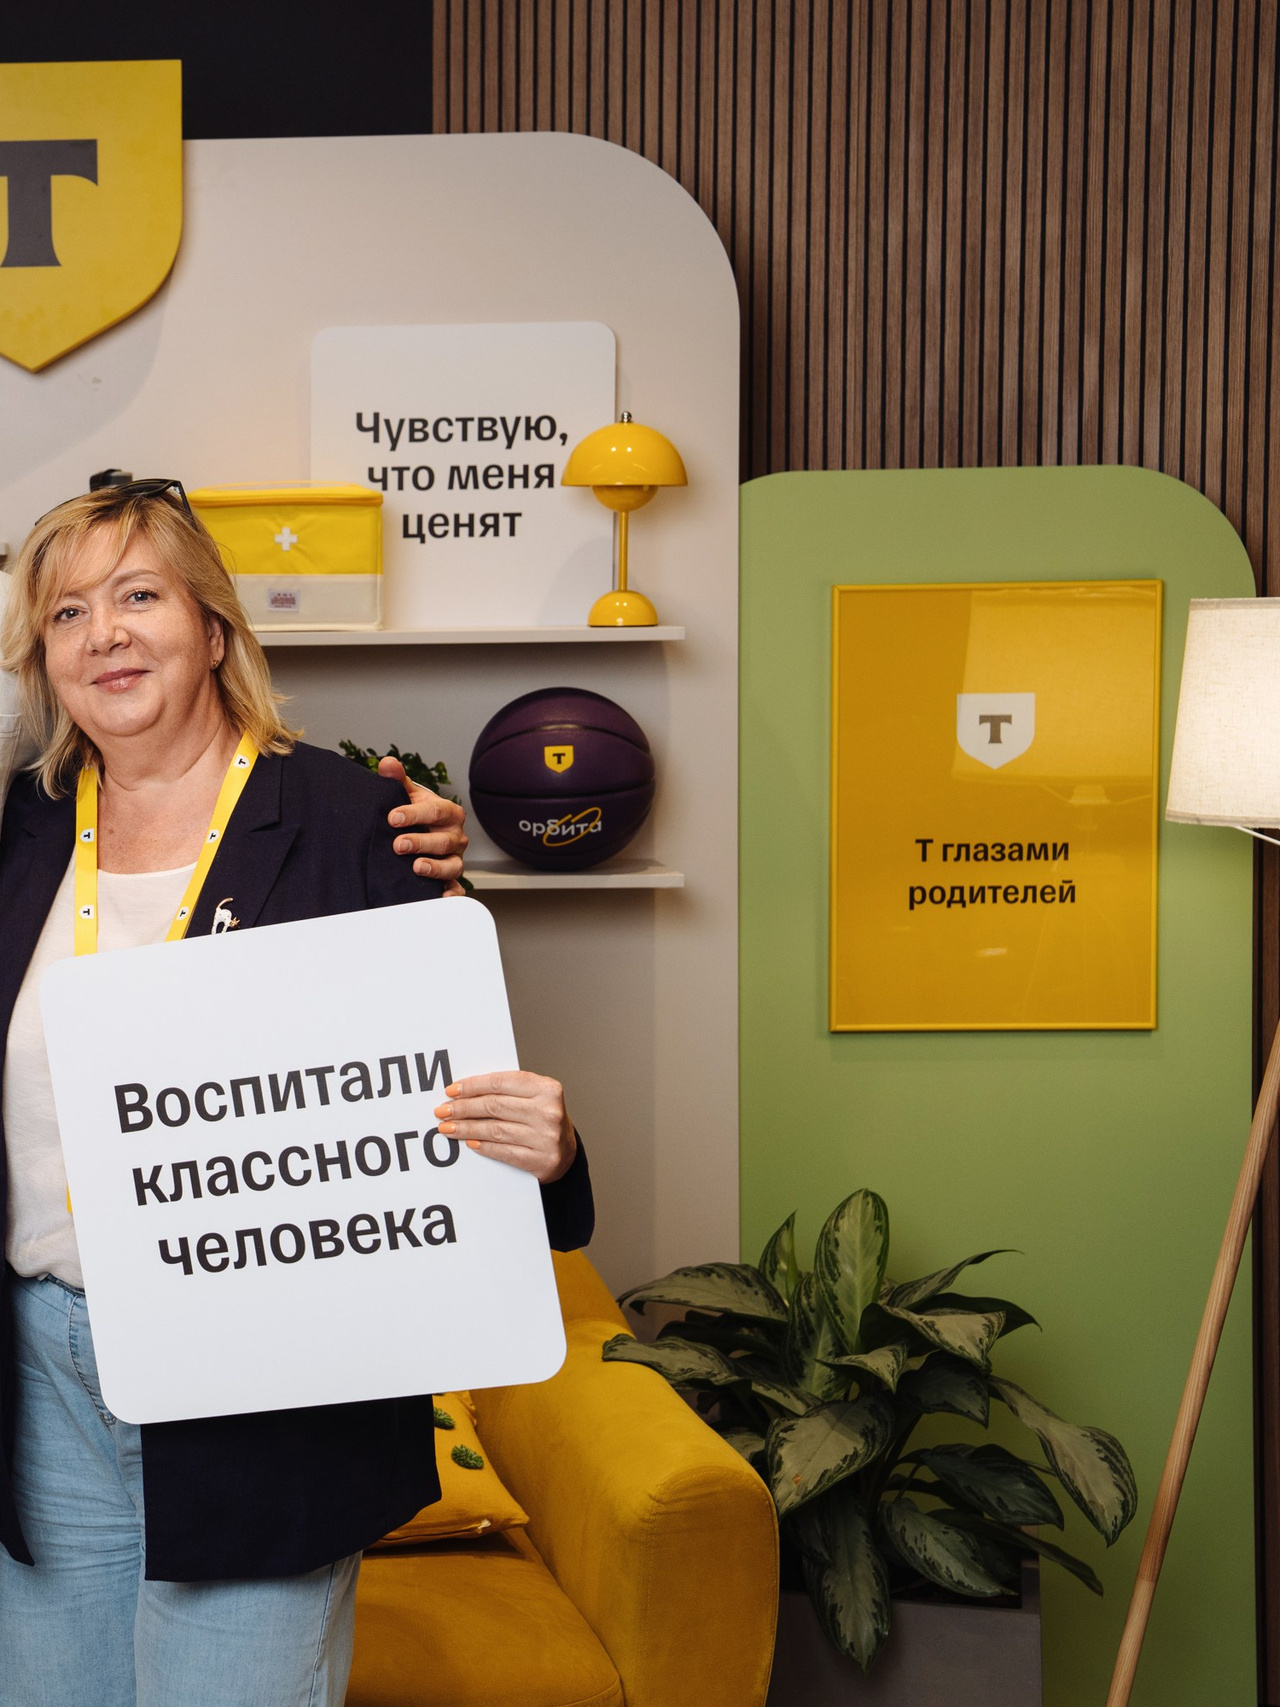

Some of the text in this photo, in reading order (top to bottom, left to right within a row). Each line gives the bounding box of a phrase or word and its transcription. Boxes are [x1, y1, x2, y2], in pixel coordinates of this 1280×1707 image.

[357, 412, 567, 451] Чувствую,
[368, 464, 554, 491] что меня
[403, 513, 522, 544] ценят
[979, 715, 1012, 744] Т
[553, 753, 565, 764] Т
[519, 817, 602, 838] орбита
[915, 839, 1070, 862] Т глазами
[909, 880, 1075, 910] родителей
[114, 1049, 454, 1135] Воспитали
[132, 1126, 460, 1207] классного
[158, 1205, 456, 1275] человека
